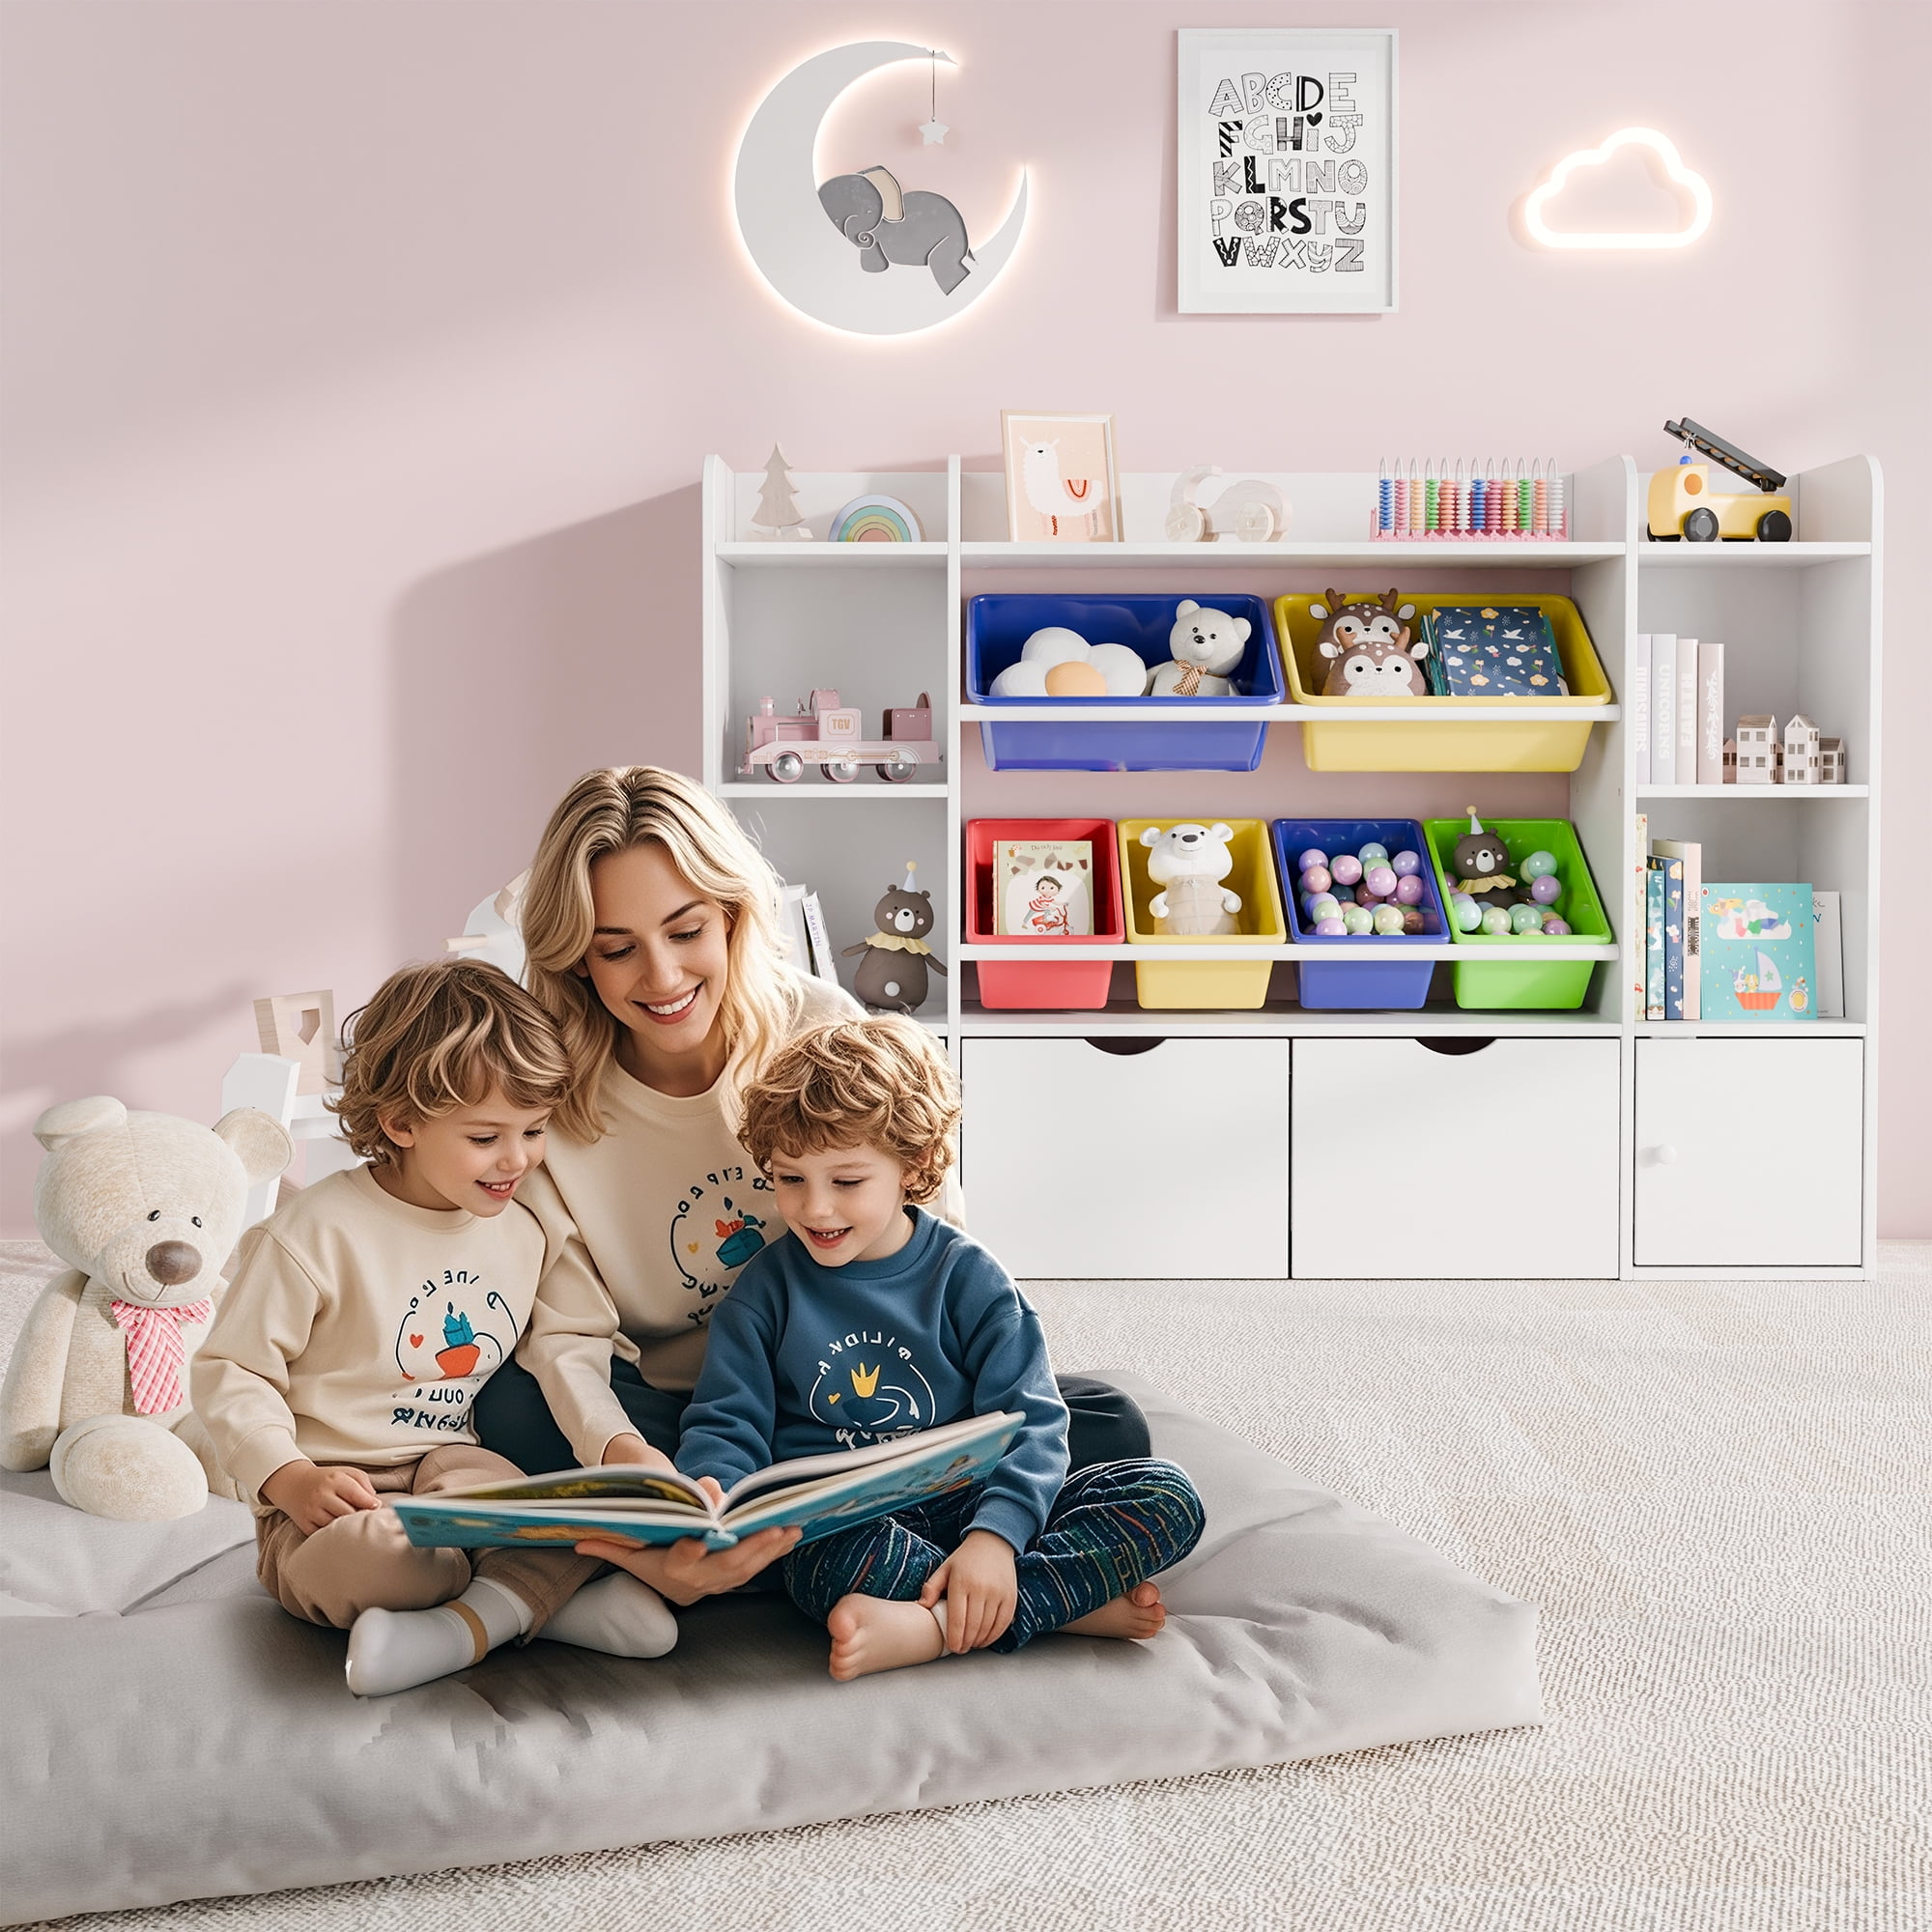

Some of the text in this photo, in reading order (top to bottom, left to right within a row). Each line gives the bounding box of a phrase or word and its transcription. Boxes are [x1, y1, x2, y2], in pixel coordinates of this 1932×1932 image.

[832, 718, 851, 730] TGV
[1659, 664, 1670, 759] UNICORNS
[1681, 672, 1693, 748] EARTH
[809, 915, 822, 948] MARTIN
